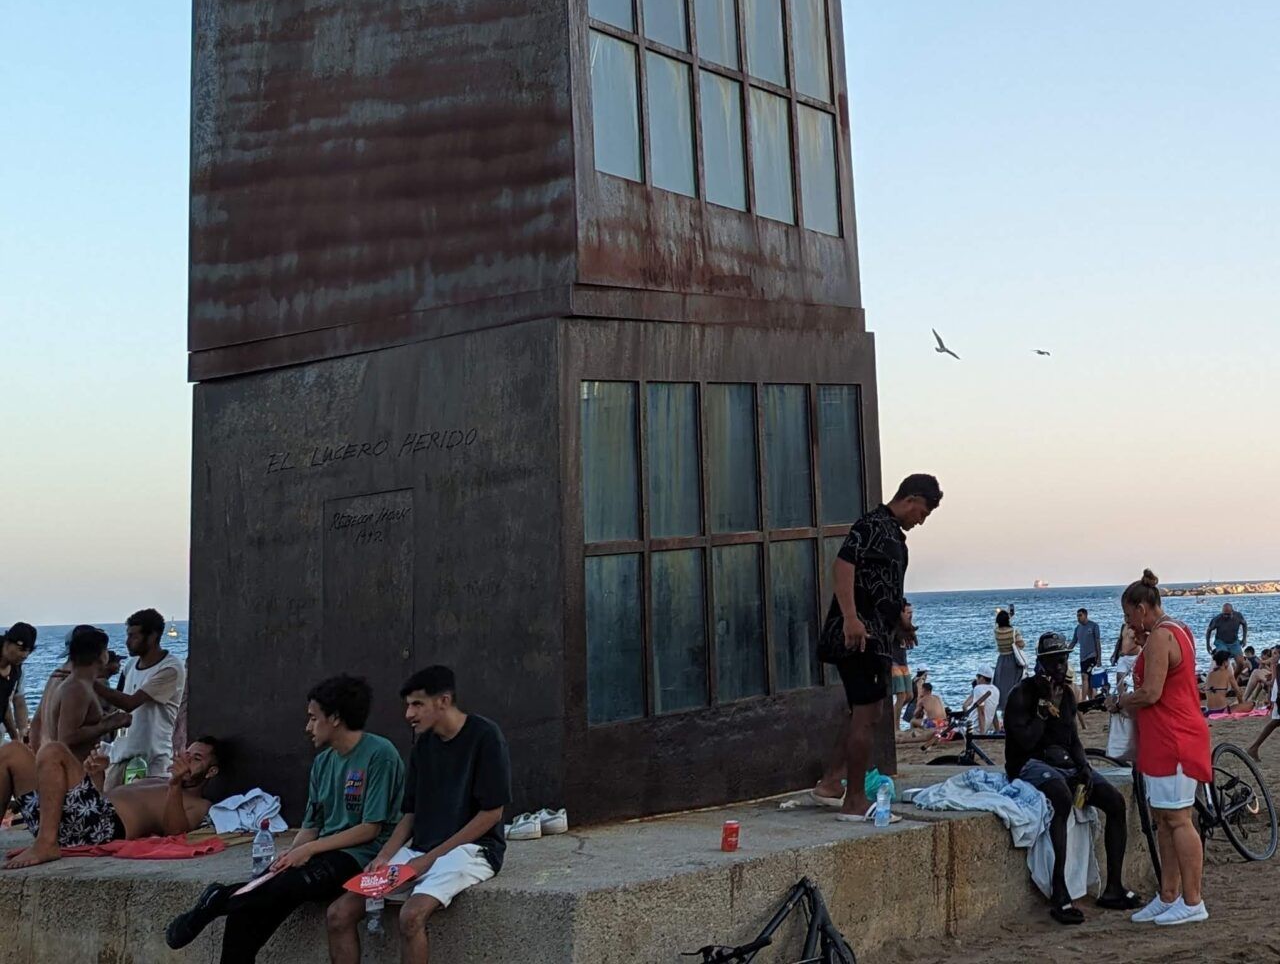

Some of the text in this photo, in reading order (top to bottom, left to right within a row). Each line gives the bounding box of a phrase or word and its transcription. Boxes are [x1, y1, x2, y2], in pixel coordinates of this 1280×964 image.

[266, 427, 478, 474] EL LUCERO HERIDO
